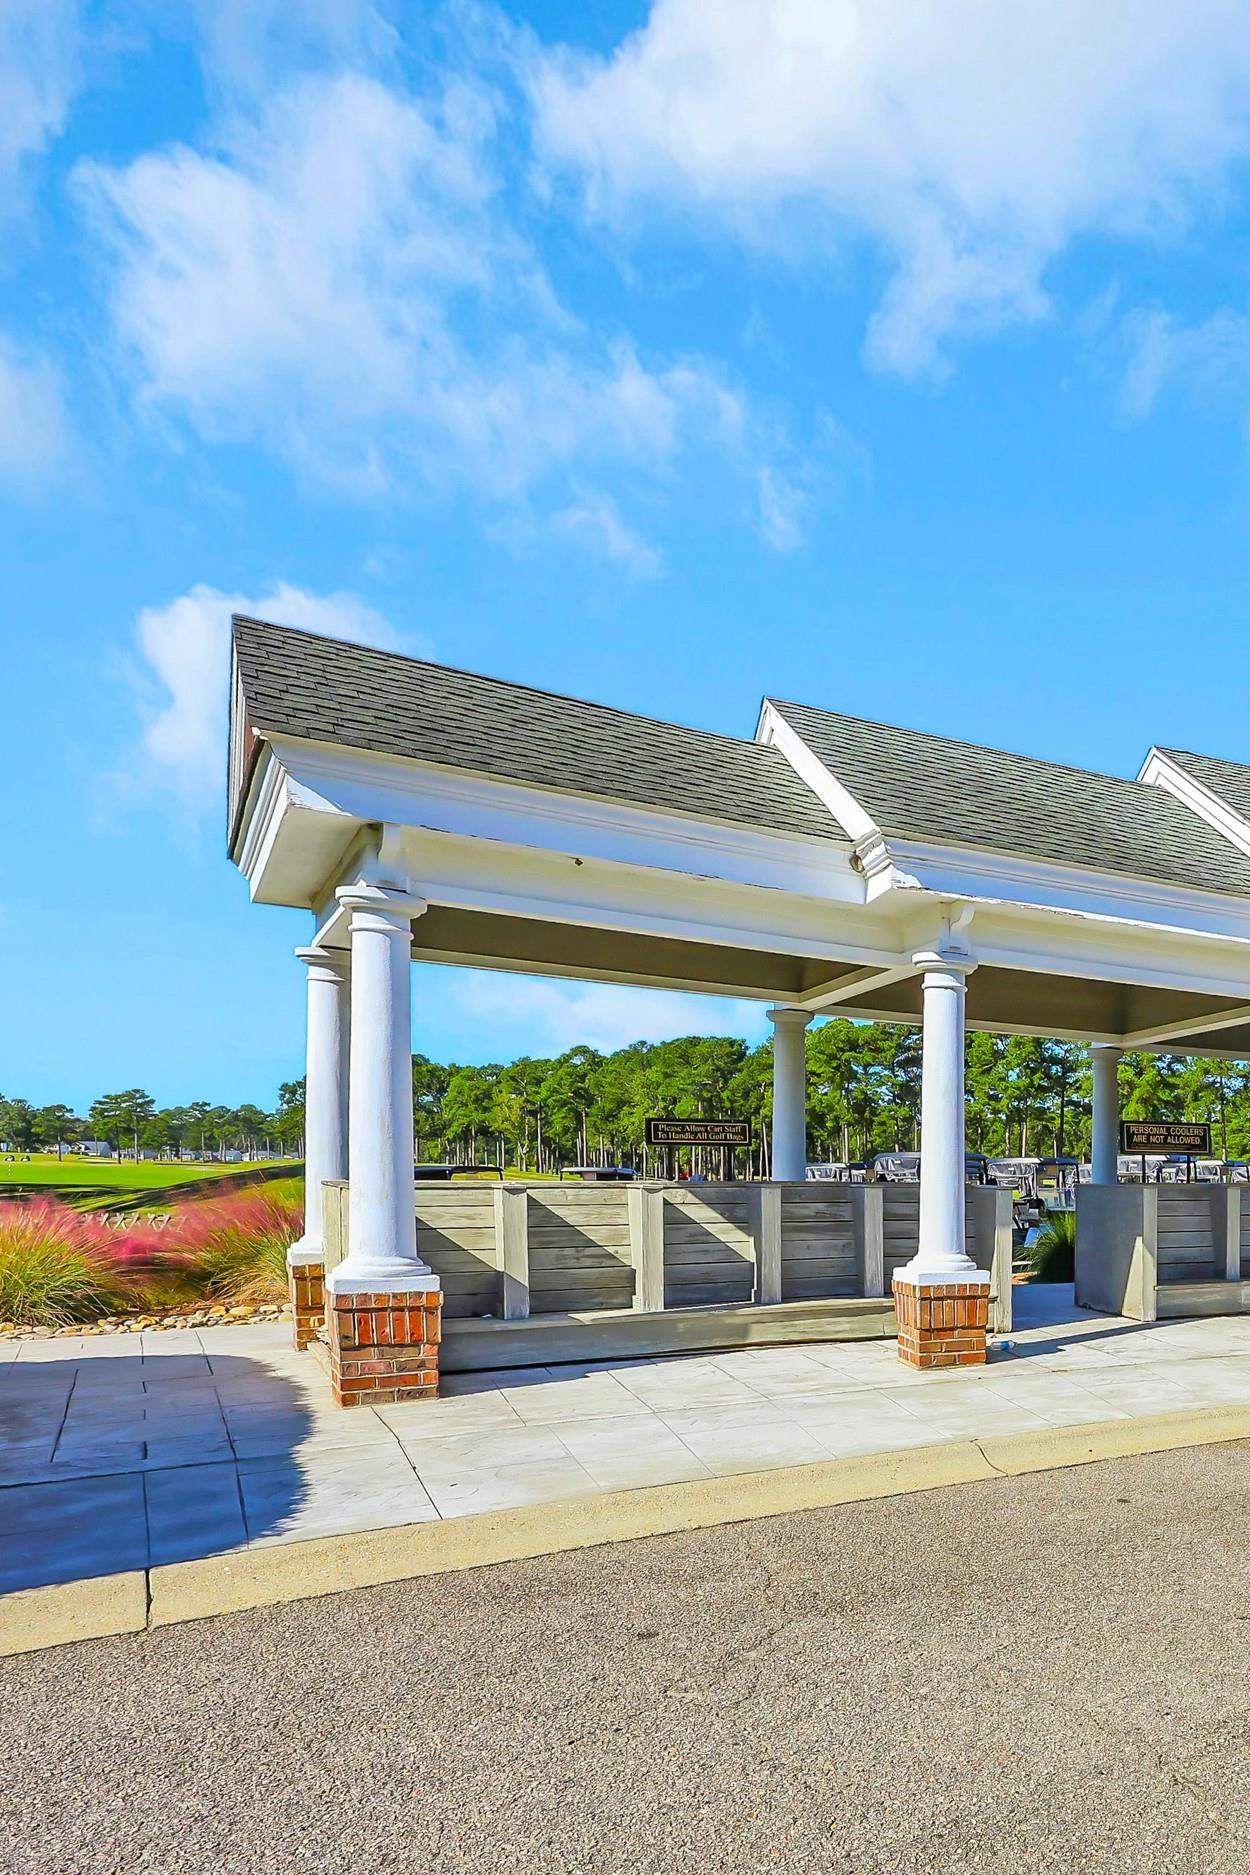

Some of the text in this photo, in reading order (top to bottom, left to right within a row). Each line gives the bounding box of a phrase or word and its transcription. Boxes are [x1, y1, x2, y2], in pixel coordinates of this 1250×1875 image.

[658, 1124, 682, 1132] Please
[684, 1124, 705, 1132] Allow
[724, 1125, 743, 1133] Staff
[1130, 1126, 1204, 1136] PERSONAL COOLERS
[657, 1131, 744, 1141] To Handle All Golf Bags
[1133, 1135, 1148, 1143] ARE
[1149, 1135, 1165, 1144] NOT
